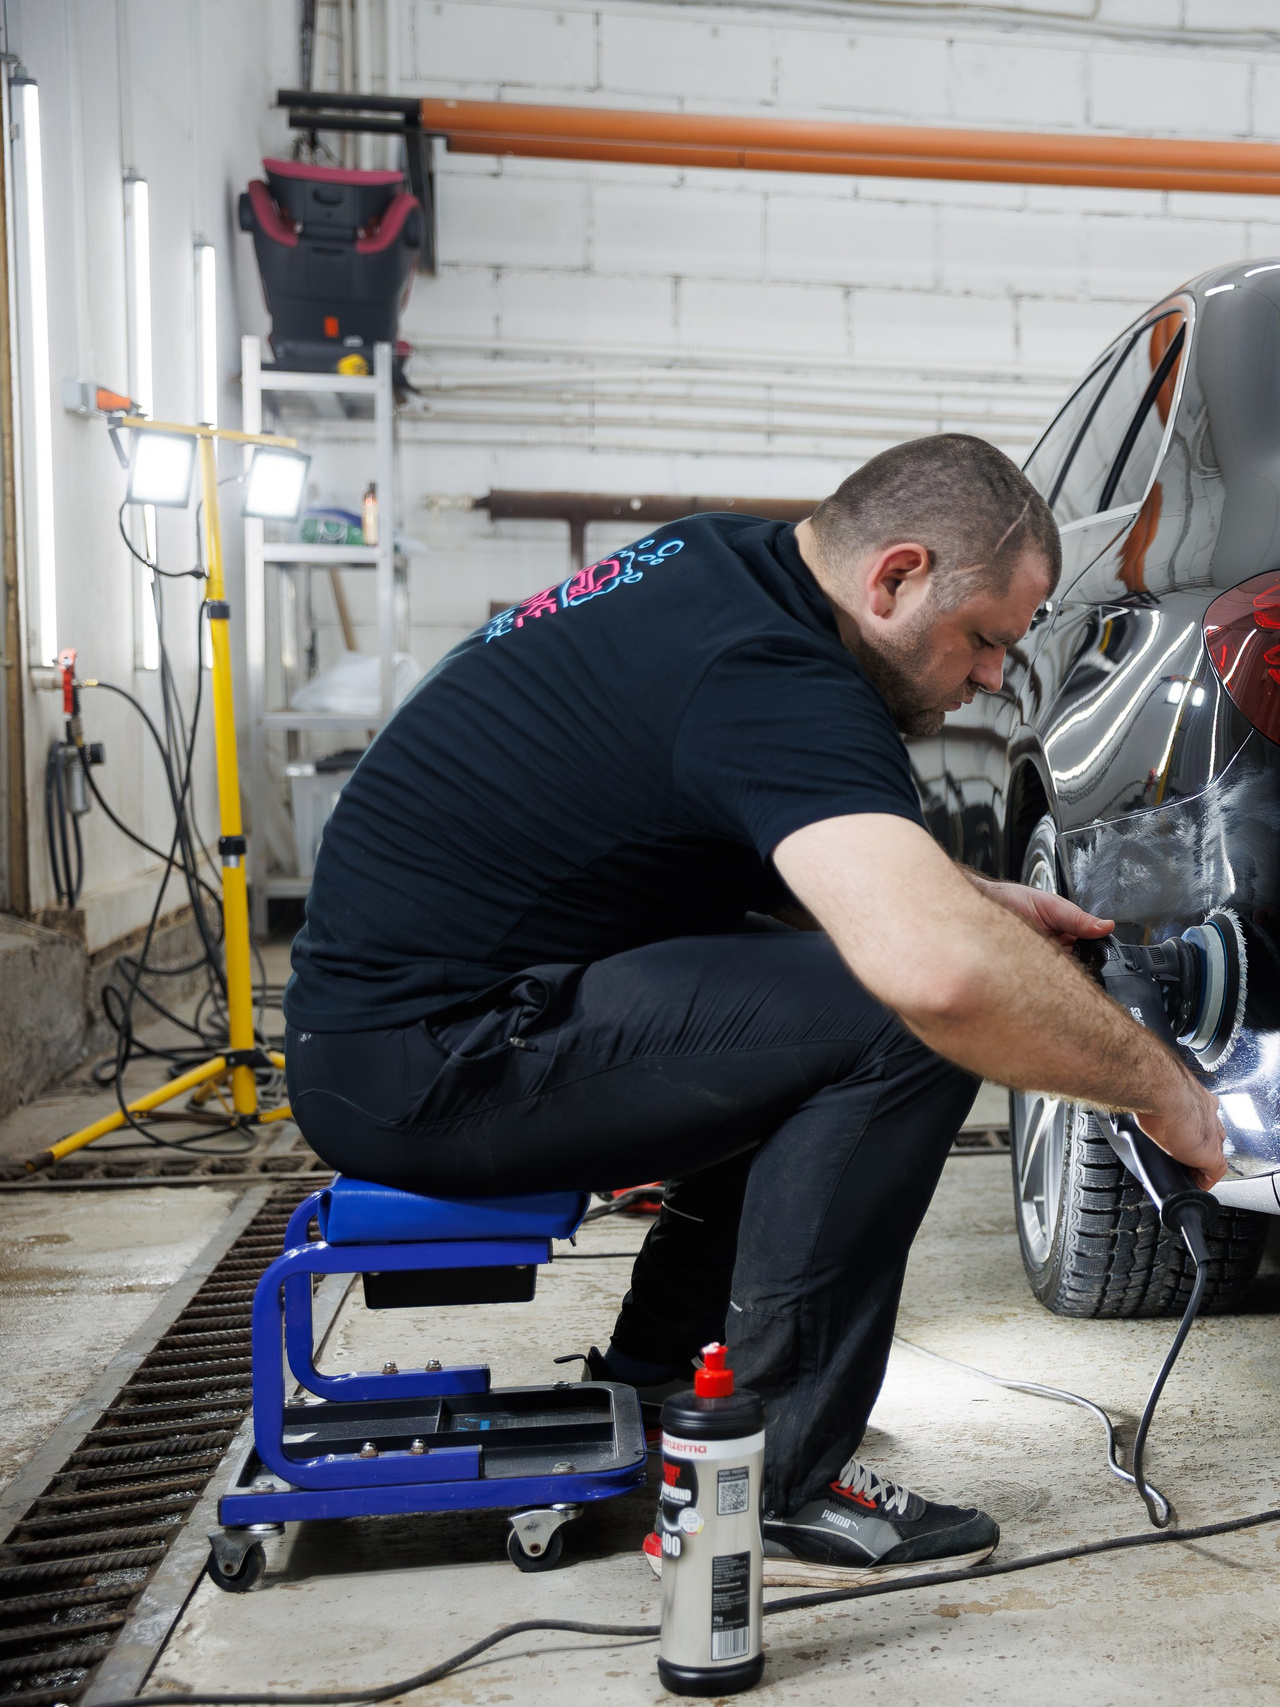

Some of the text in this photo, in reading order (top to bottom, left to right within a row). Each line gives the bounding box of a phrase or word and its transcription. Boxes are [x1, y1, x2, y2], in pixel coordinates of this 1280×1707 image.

[663, 1437, 708, 1454] enzerna
[662, 1481, 692, 1502] POUND
[821, 1508, 852, 1529] PUMA
